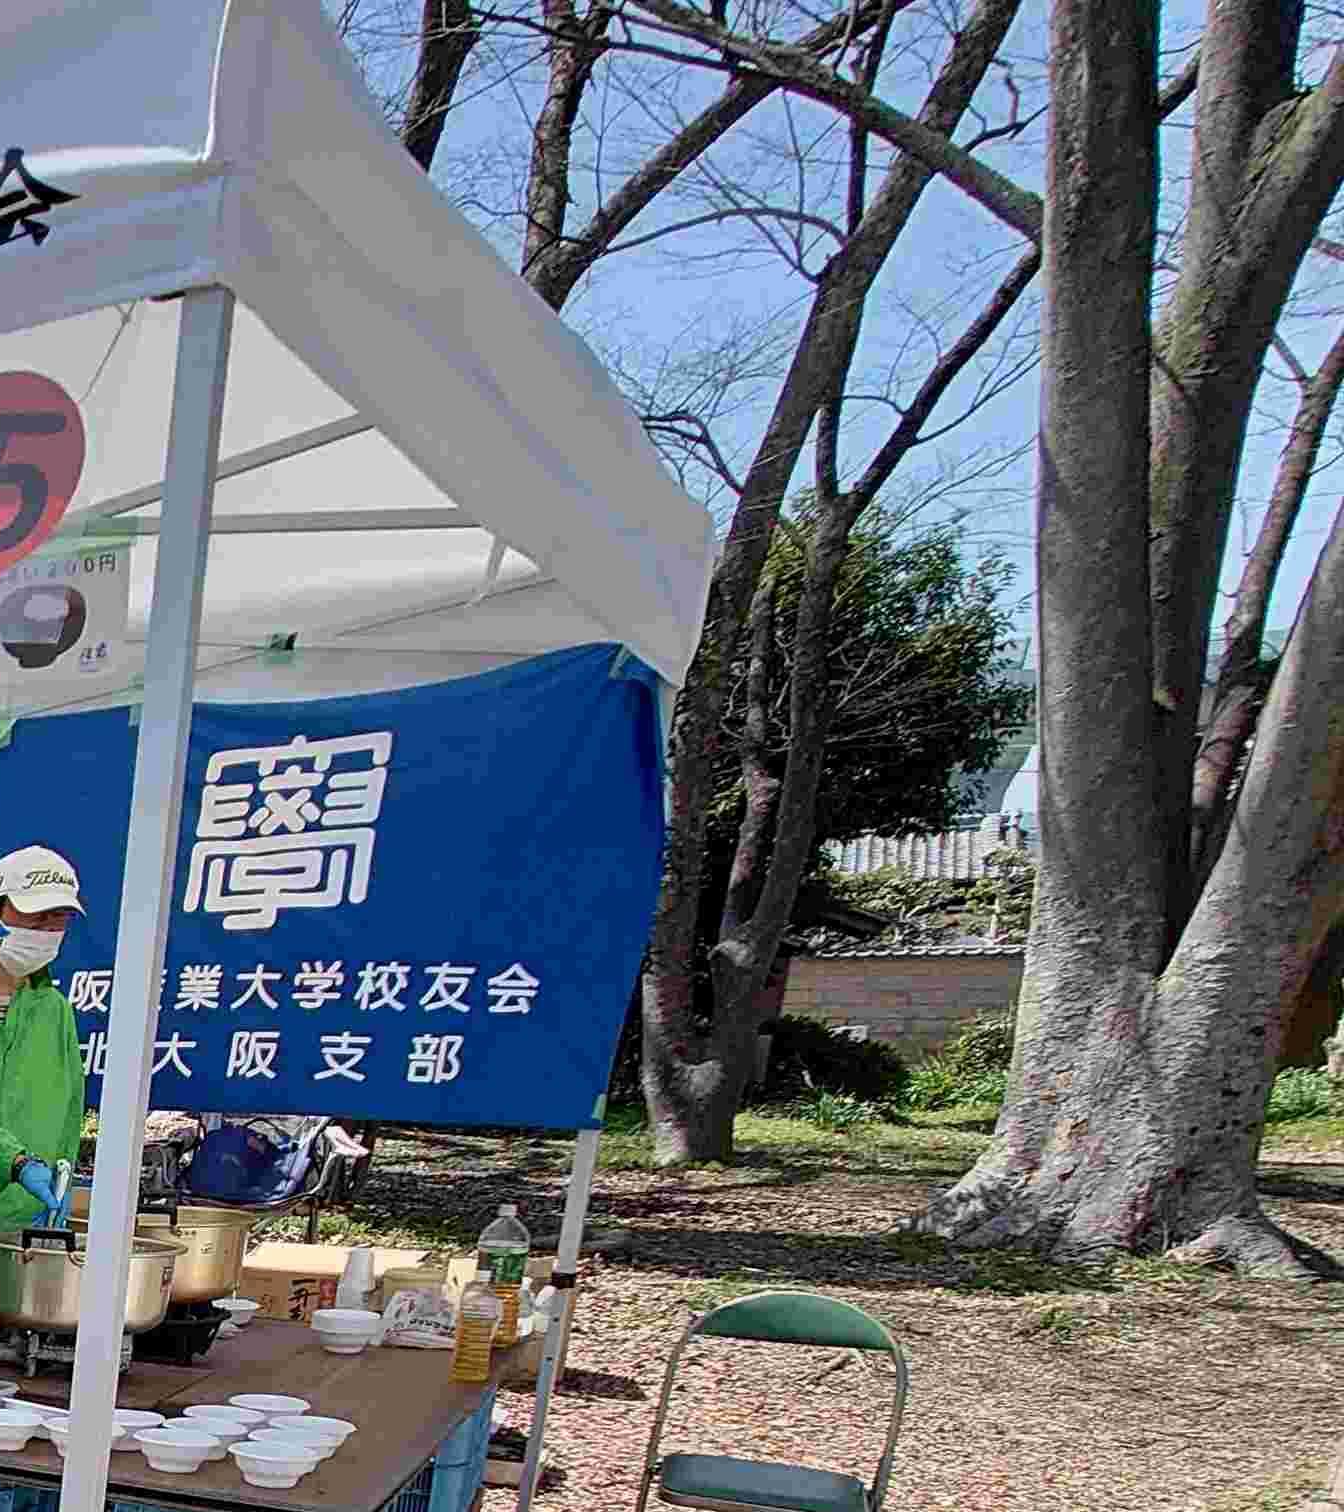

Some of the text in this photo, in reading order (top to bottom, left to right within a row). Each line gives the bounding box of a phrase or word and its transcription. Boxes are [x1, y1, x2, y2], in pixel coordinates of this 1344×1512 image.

[50, 960, 540, 1015] 阪業大学校友会
